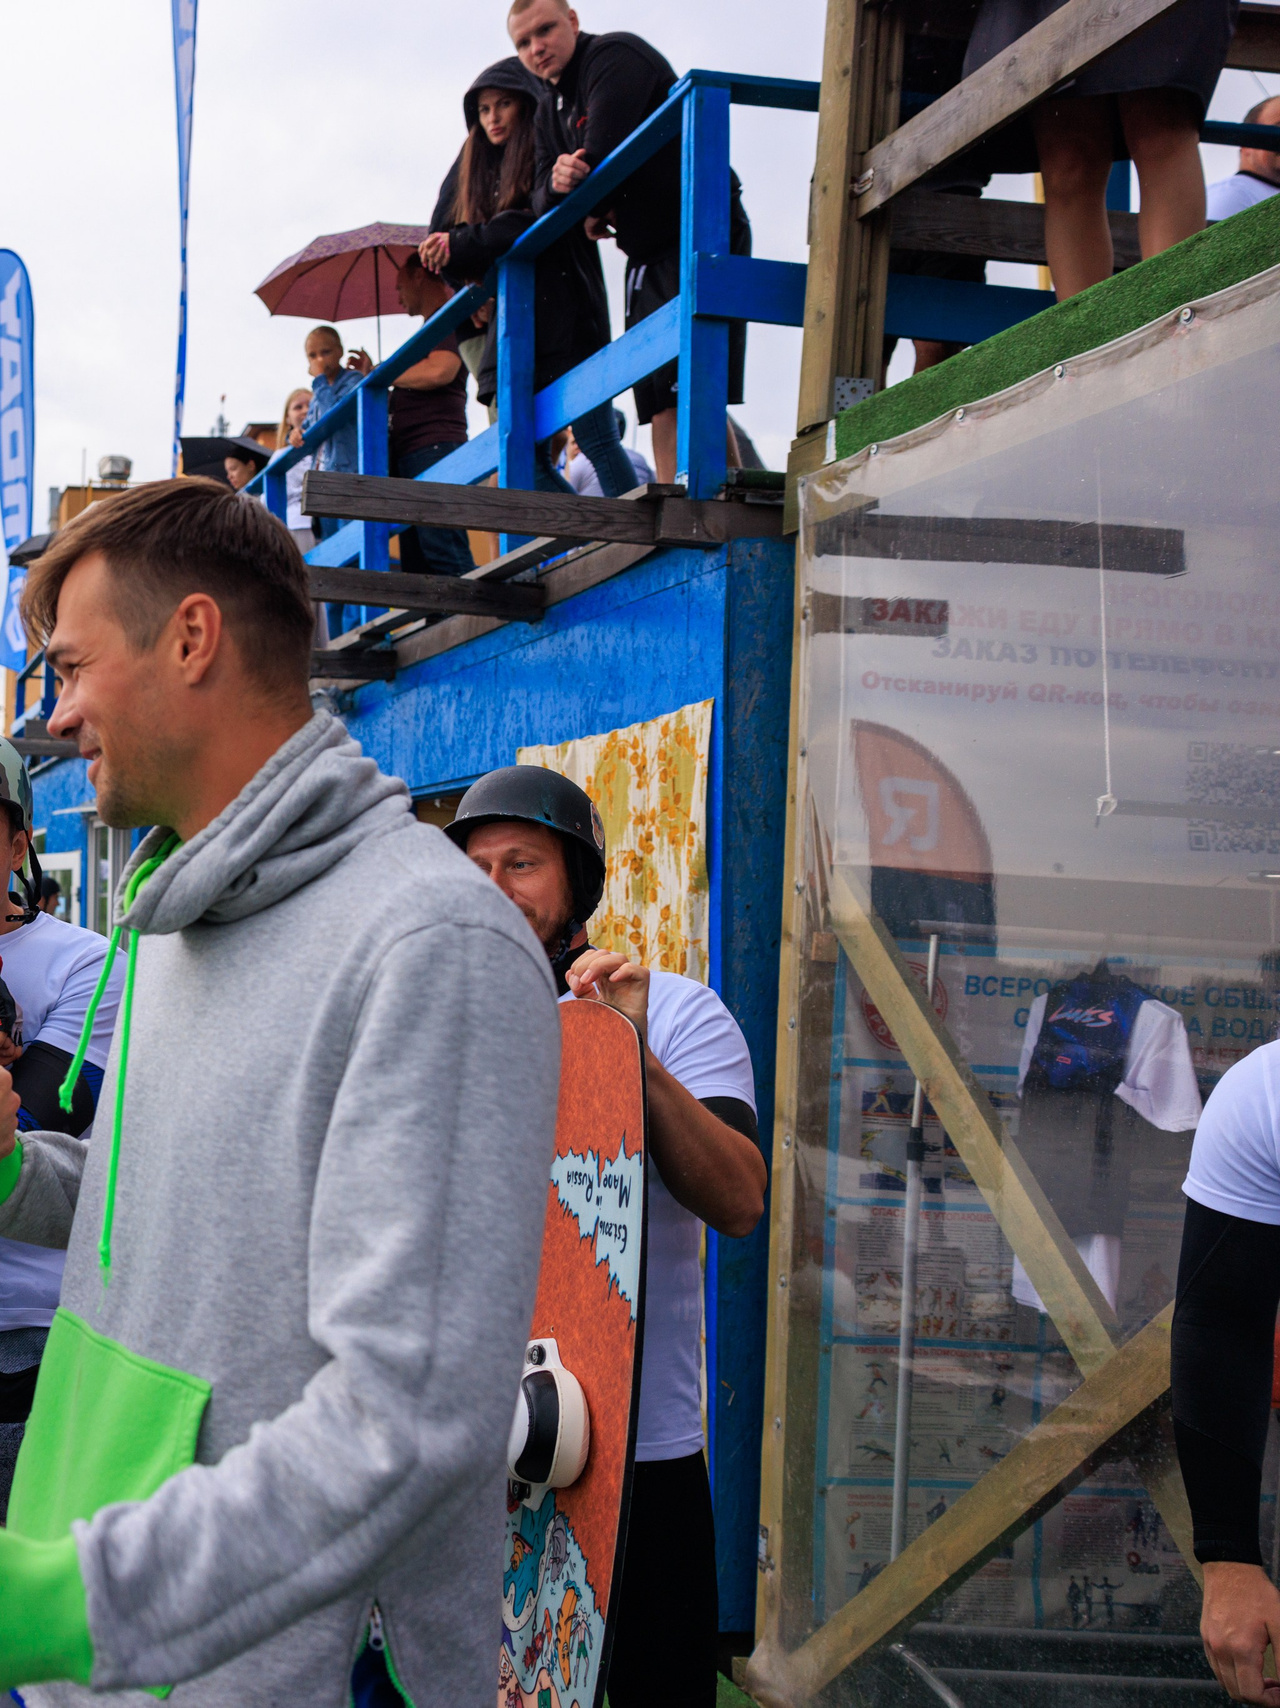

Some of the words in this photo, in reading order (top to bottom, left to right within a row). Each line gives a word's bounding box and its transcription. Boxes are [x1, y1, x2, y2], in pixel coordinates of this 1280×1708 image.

[931, 637, 1039, 665] ЗАКАЗ
[1050, 644, 1097, 668] ПО
[861, 669, 1019, 704] Отсканируй
